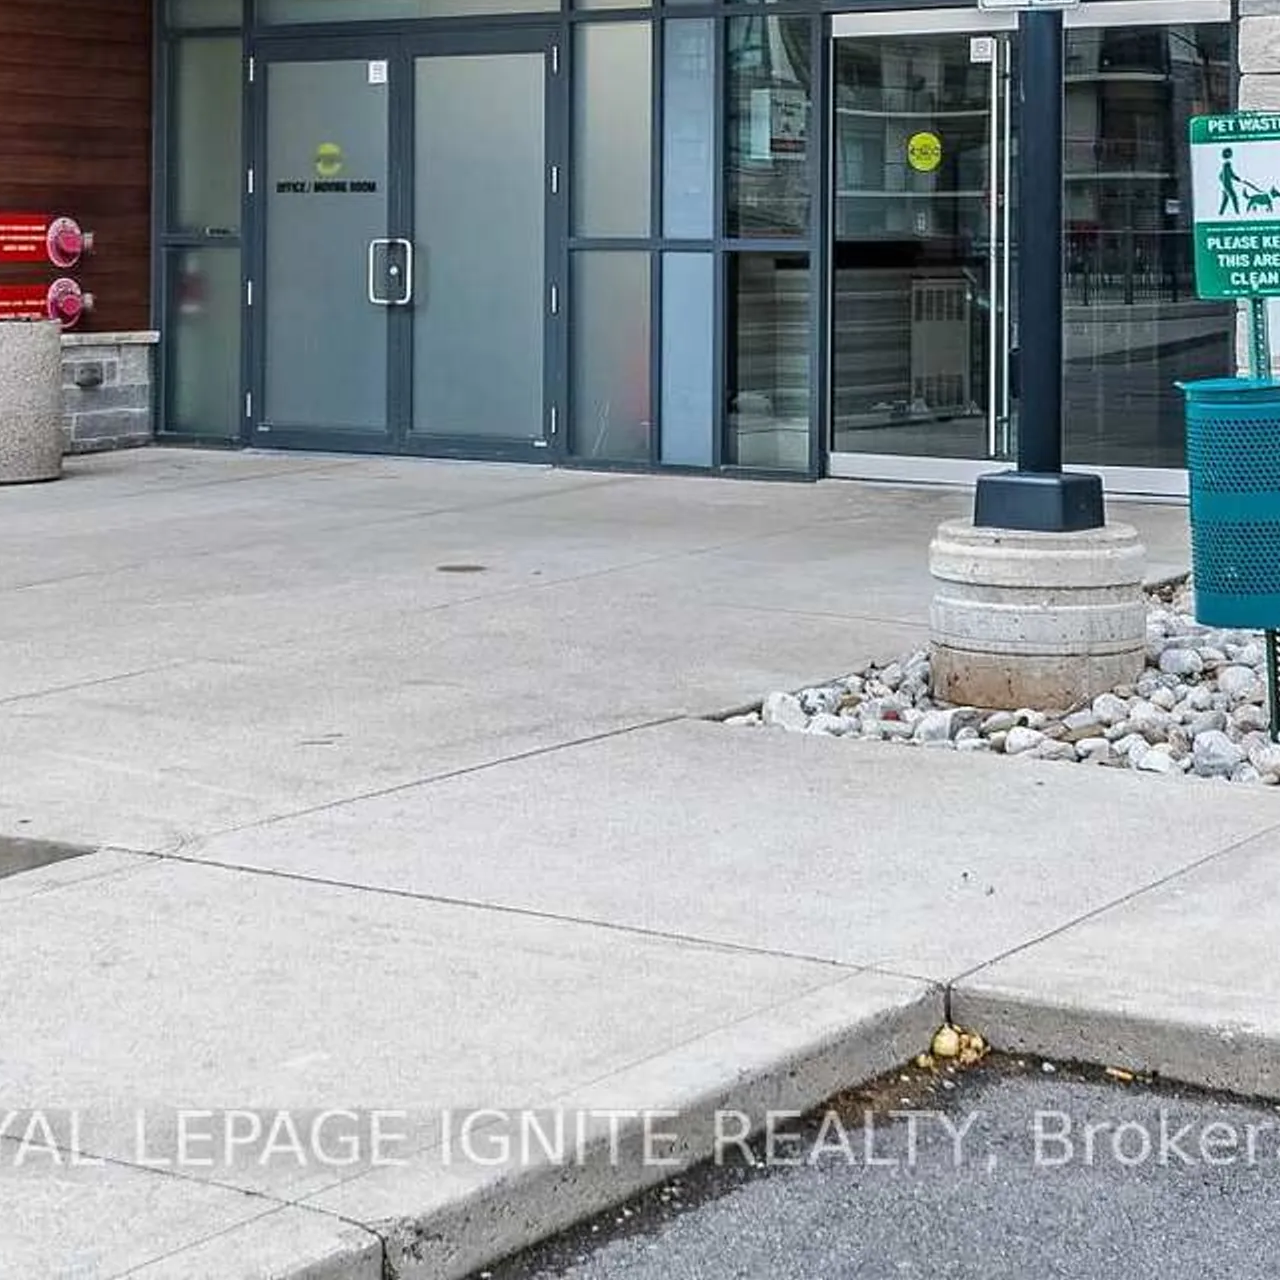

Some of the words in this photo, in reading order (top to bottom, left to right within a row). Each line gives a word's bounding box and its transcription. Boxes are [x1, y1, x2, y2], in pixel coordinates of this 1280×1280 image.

[1208, 118, 1236, 133] PET
[1207, 236, 1259, 250] PLEASE
[1218, 254, 1250, 267] THIS
[1230, 272, 1279, 286] CLEAN
